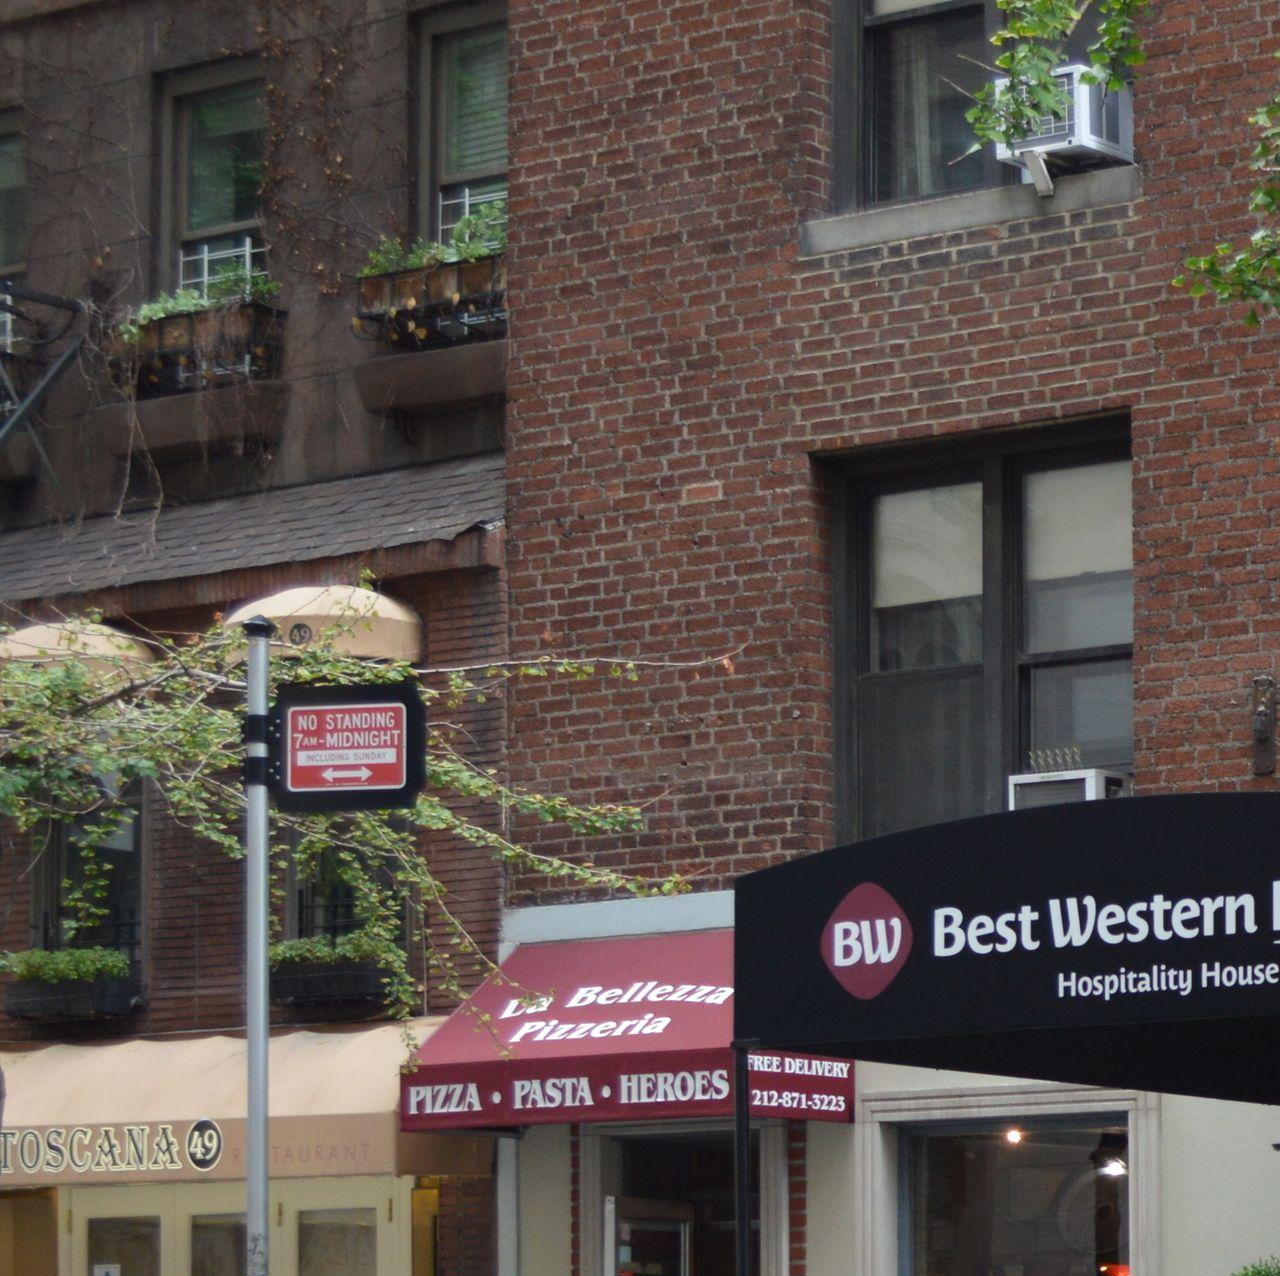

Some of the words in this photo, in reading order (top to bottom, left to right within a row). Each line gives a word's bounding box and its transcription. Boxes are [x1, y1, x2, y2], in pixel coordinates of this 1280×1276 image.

[298, 715, 318, 731] NO
[326, 712, 395, 730] STANDING
[306, 752, 350, 762] INCLUDING
[353, 751, 388, 761] SUNDAY
[833, 916, 902, 967] BW
[933, 906, 1041, 957] Best
[1049, 895, 1258, 949] Western
[500, 996, 554, 1020] La
[565, 981, 734, 1008] Bellezza
[1058, 964, 1193, 1001] Hospitality
[1201, 961, 1280, 989] House
[509, 1013, 672, 1042] Pizzeria
[747, 1054, 782, 1073] FREE
[784, 1057, 851, 1079] DELIVERY
[409, 1083, 483, 1115] PIZZA
[513, 1077, 594, 1109] PASTA
[619, 1069, 731, 1104] HEROES
[752, 1089, 846, 1112] 212-871-3223
[0, 1125, 182, 1174] TOSCANA
[190, 1128, 220, 1162] 49
[233, 1143, 371, 1167] RTAURANT
